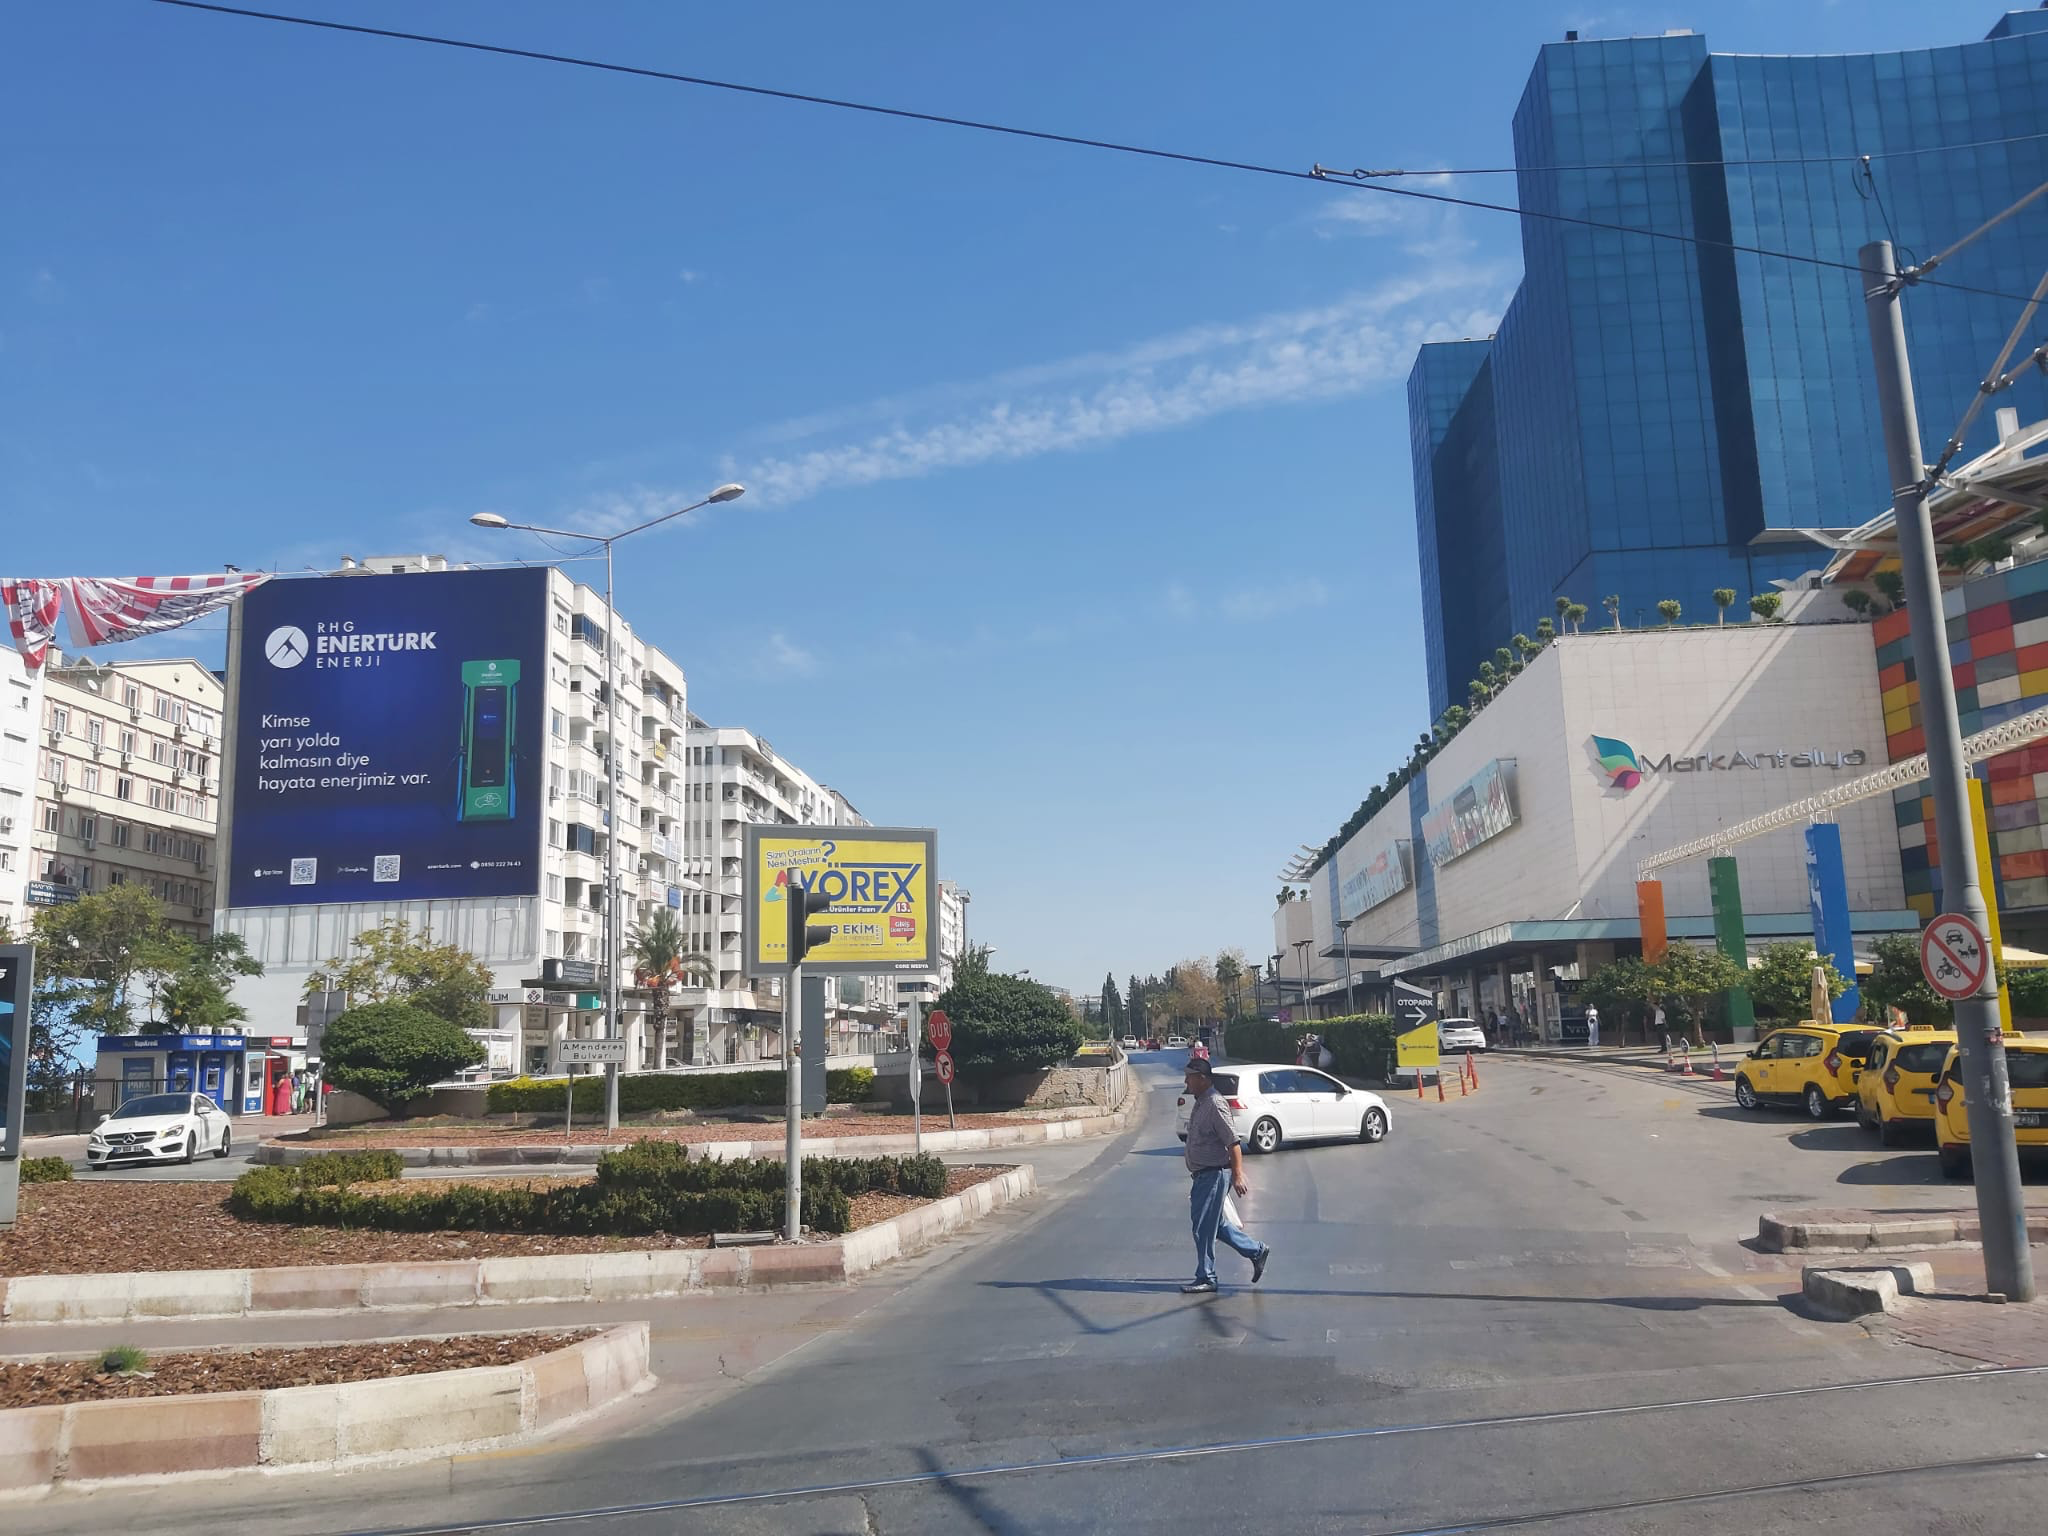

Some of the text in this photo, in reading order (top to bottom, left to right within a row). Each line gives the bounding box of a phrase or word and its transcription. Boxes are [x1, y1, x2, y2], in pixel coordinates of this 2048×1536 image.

[317, 621, 355, 633] RHG
[262, 714, 311, 728] Kimse
[261, 732, 341, 752] yarı yolda
[260, 752, 370, 770] kalmasın diye
[1639, 747, 1866, 773] MarkAntalya
[258, 772, 431, 793] hayata enerjimiz var.
[896, 902, 911, 912] 13.
[843, 922, 874, 934] EKİM
[929, 1023, 950, 1038] DUR
